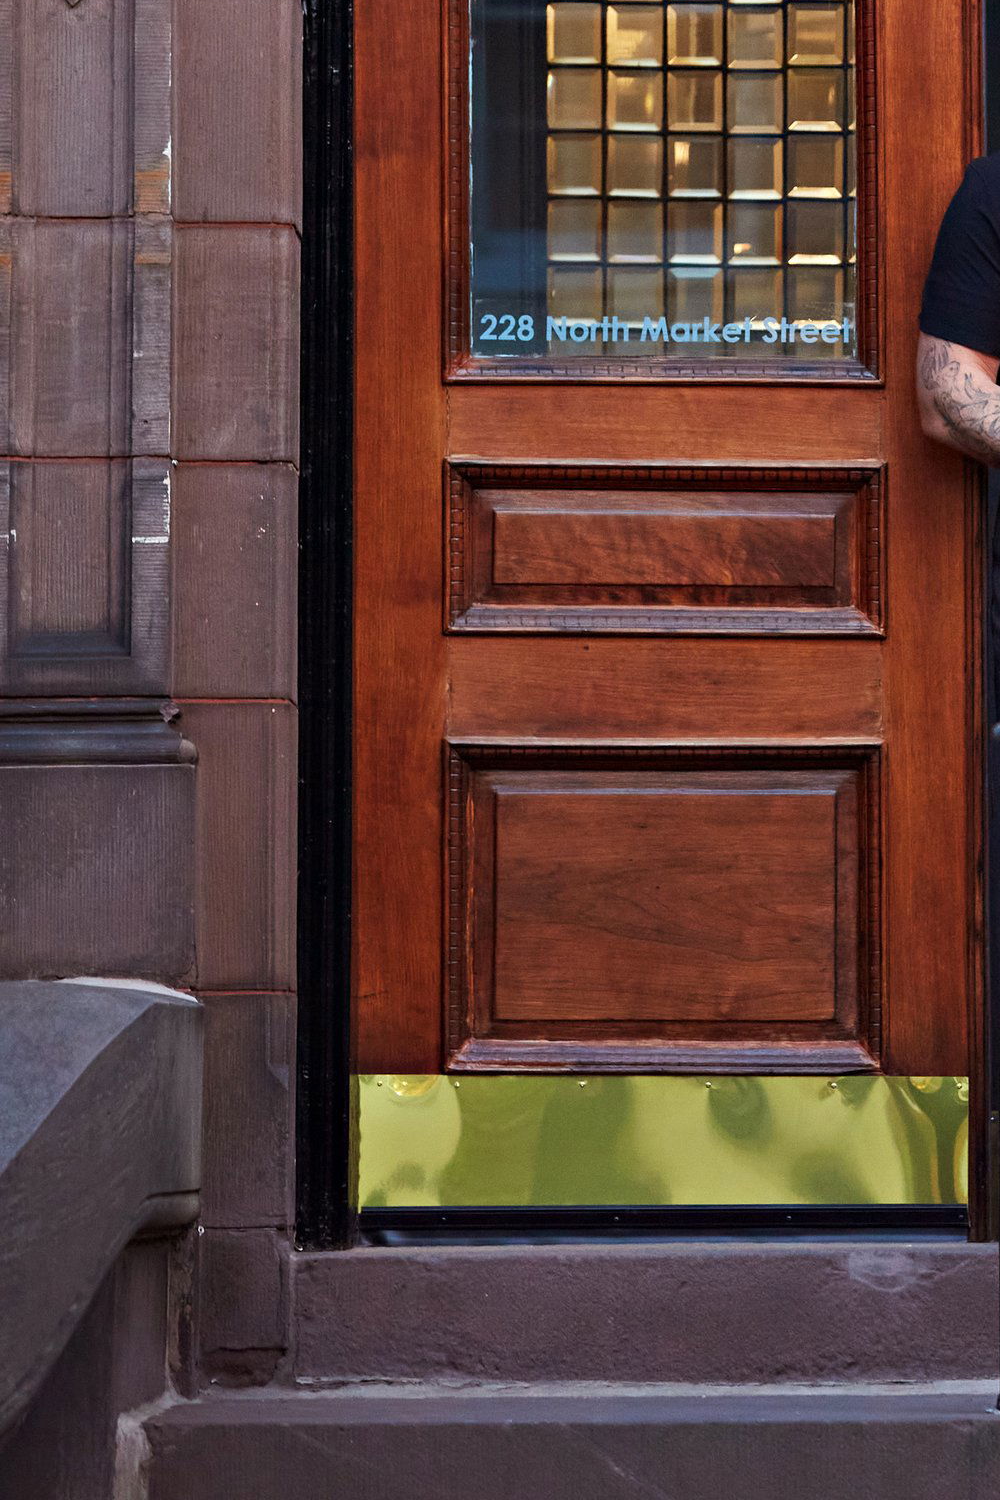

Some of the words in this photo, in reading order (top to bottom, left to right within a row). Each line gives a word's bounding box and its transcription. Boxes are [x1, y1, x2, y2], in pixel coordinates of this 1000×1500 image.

[479, 314, 535, 342] 228
[546, 315, 630, 343] North
[639, 316, 753, 343] Market
[762, 316, 851, 344] Street
